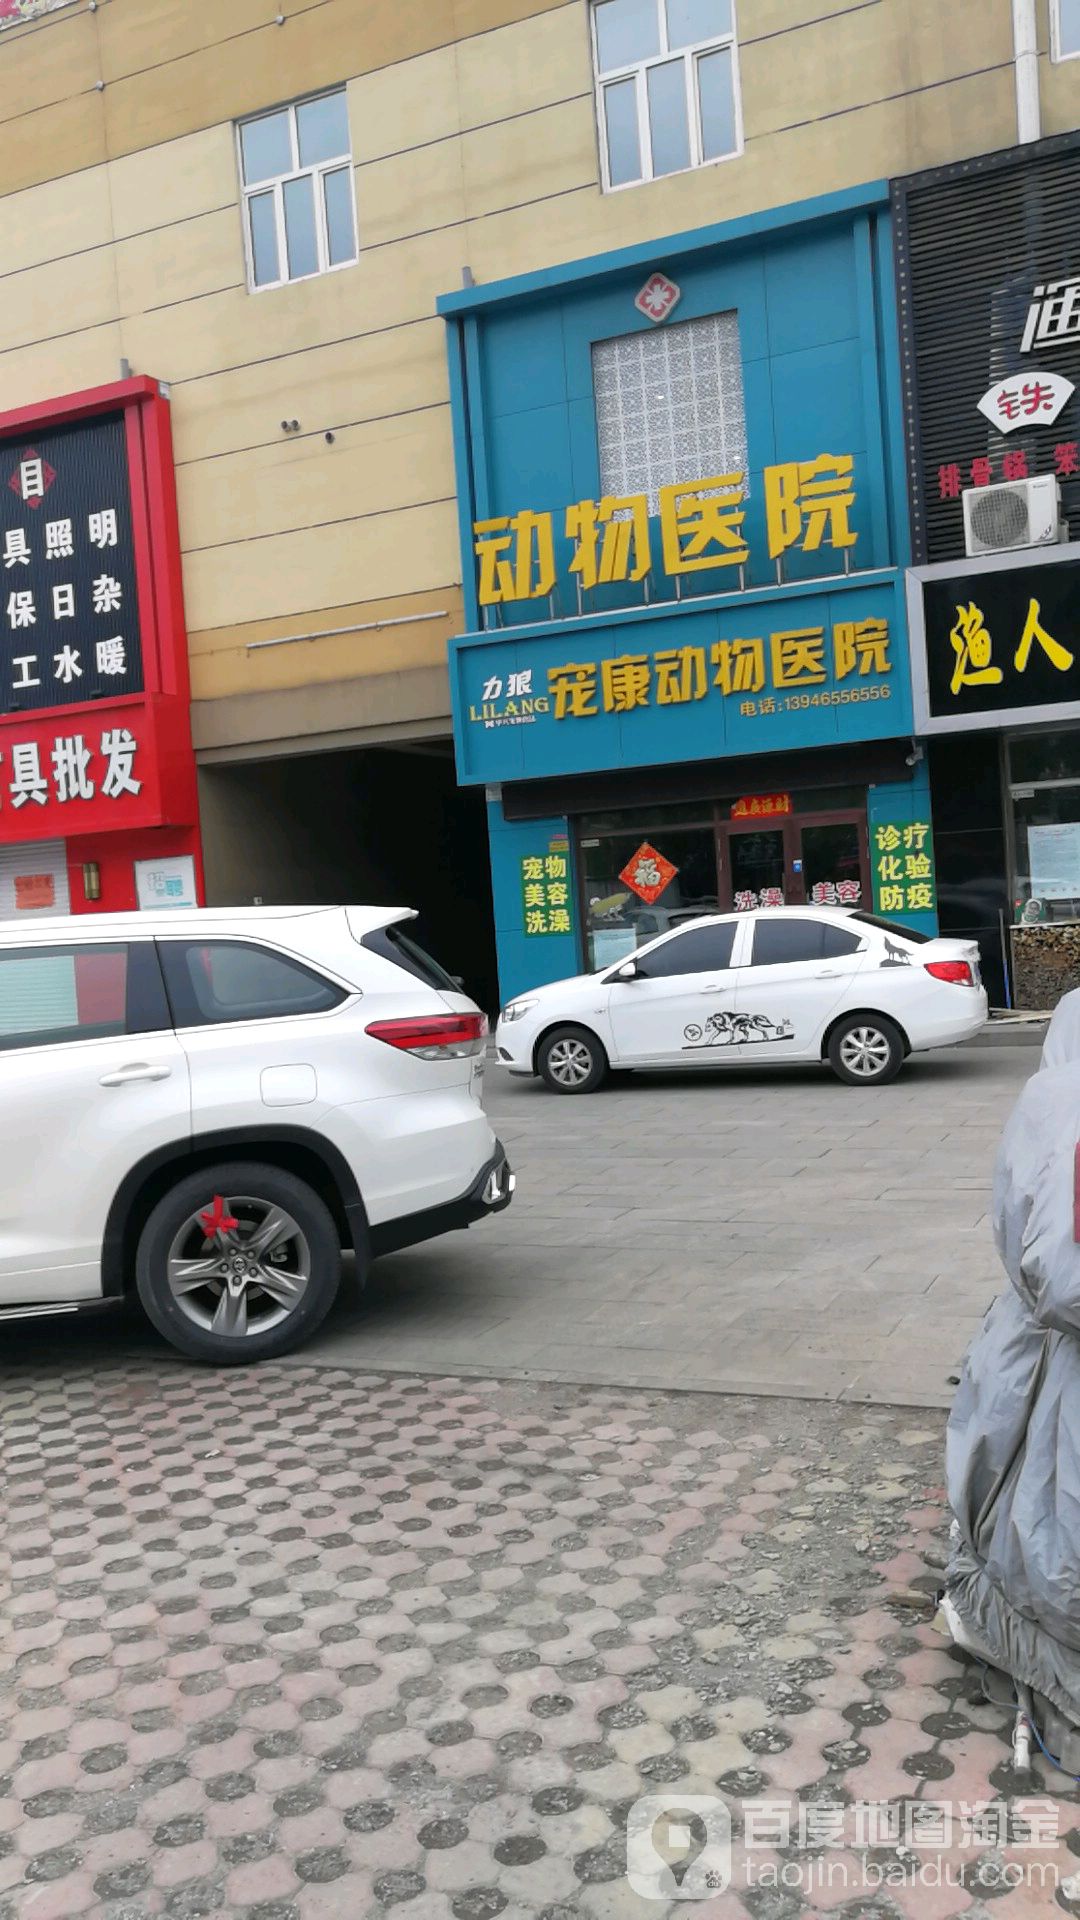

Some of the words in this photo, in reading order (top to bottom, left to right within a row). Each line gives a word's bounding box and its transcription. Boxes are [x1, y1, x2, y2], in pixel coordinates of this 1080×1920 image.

[20, 458, 44, 500] 目
[938, 450, 1028, 499] 排骨锅
[473, 453, 859, 606] 动物医院
[950, 598, 1074, 695] 渔人
[547, 617, 892, 720] 宠康动物医院
[482, 669, 533, 701] 力狼
[469, 697, 549, 721] LILANG
[0, 729, 141, 808] 具批发
[875, 823, 930, 850] 诊疗
[522, 855, 566, 880] 宠物
[633, 858, 661, 887] 福
[877, 853, 932, 881] 化验
[525, 882, 568, 907] 美容
[734, 887, 785, 911] 洗澡
[812, 879, 862, 905] 美容
[880, 882, 934, 911] 防疫
[526, 909, 570, 934] 洗澡
